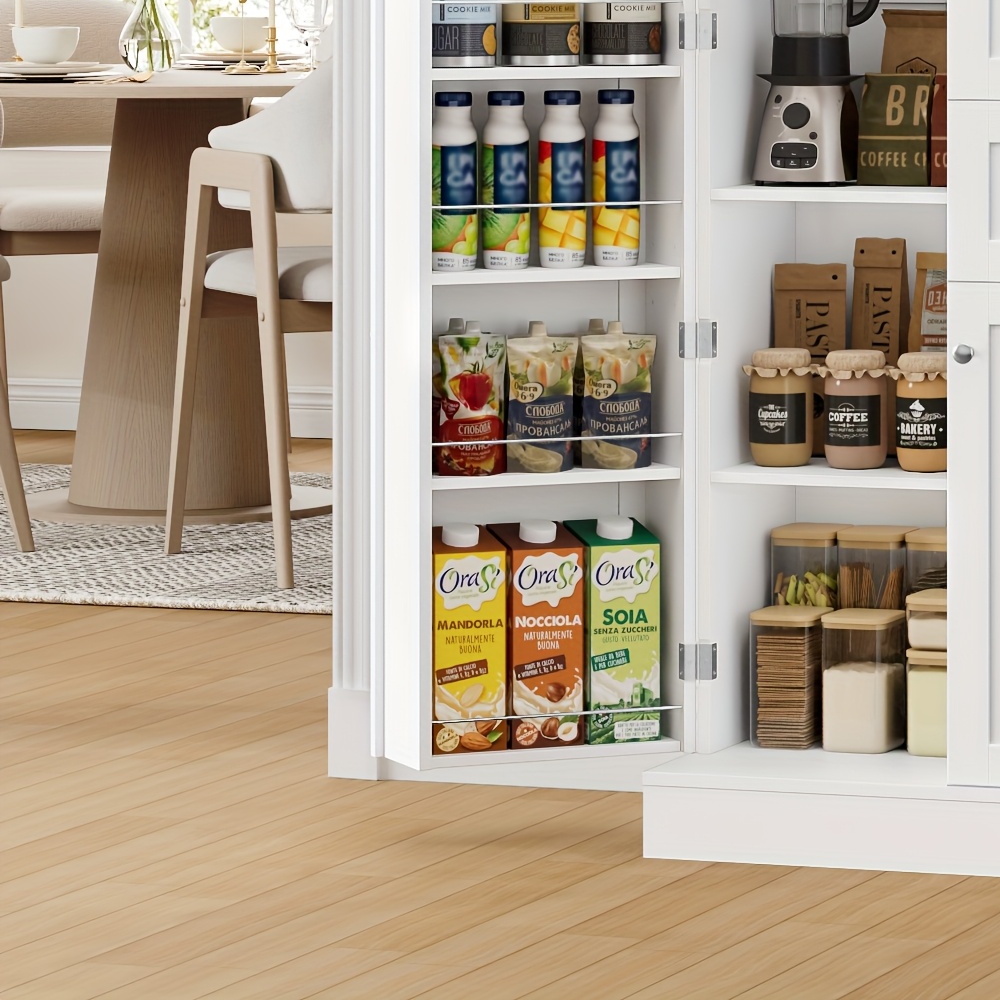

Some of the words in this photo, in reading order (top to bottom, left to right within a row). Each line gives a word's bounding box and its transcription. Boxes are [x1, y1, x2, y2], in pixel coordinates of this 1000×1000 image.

[531, 5, 563, 13] COOKIE
[613, 4, 645, 12] COOKIE
[860, 151, 907, 168] COFFEE
[872, 287, 893, 358] PAST
[525, 403, 565, 417] СЛОБОДА
[599, 400, 641, 413] СЛОБОДА
[757, 407, 788, 421] Cupcakes
[828, 412, 869, 422] COFFEE
[458, 423, 492, 436] СЛОБОДА
[515, 418, 572, 437] ПРОВАНСАЛЬ
[590, 417, 649, 433] ПРОВАНСАЛЬ
[900, 422, 937, 435] BAKERY
[515, 615, 582, 628] NOCCIOLA
[603, 609, 648, 625] SOIA
[437, 618, 504, 630] MANDORLA
[593, 627, 619, 635] SENZA
[621, 625, 658, 634] ZUCCHERI
[445, 633, 495, 645] NATURALMENTE
[523, 629, 573, 641] NATURALMENTE
[459, 644, 482, 655] BUONA
[537, 640, 560, 651] BUONA
